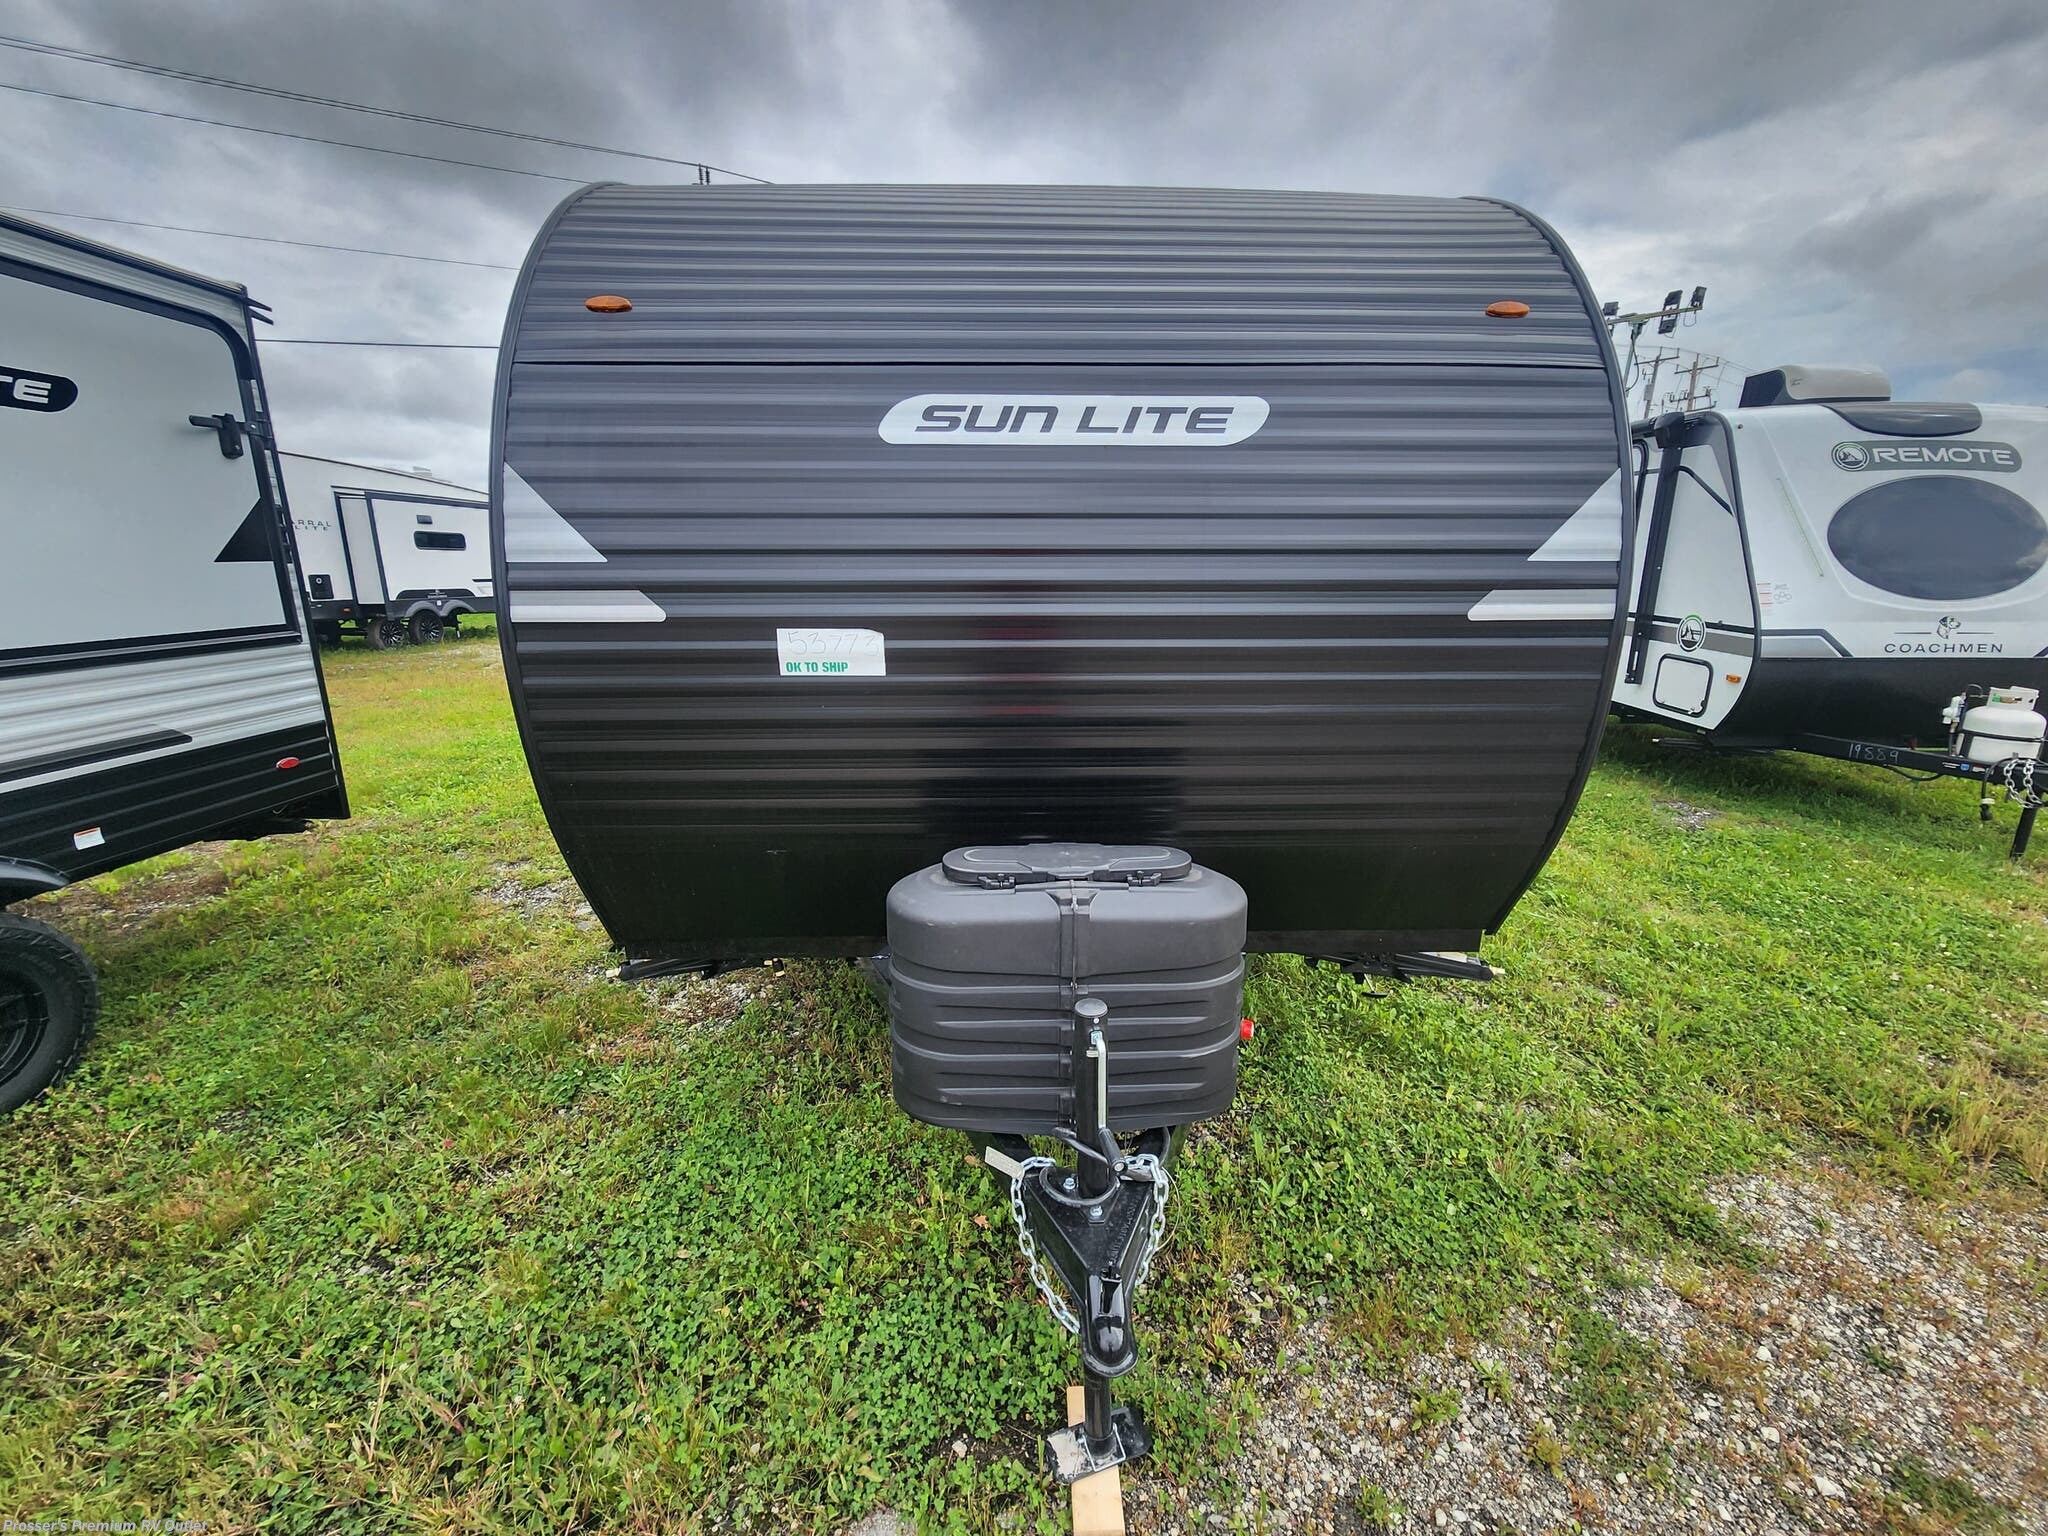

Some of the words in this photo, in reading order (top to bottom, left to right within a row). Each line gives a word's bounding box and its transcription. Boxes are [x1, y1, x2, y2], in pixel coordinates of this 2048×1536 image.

[914, 405, 1060, 433] SUN
[1075, 406, 1235, 434] LITE
[1873, 447, 2015, 466] REMOTE
[293, 519, 332, 527] RRAL
[1884, 643, 2003, 653] COACHMEN
[786, 662, 801, 673] OK
[804, 662, 819, 673] TO
[822, 662, 848, 673] SHIP
